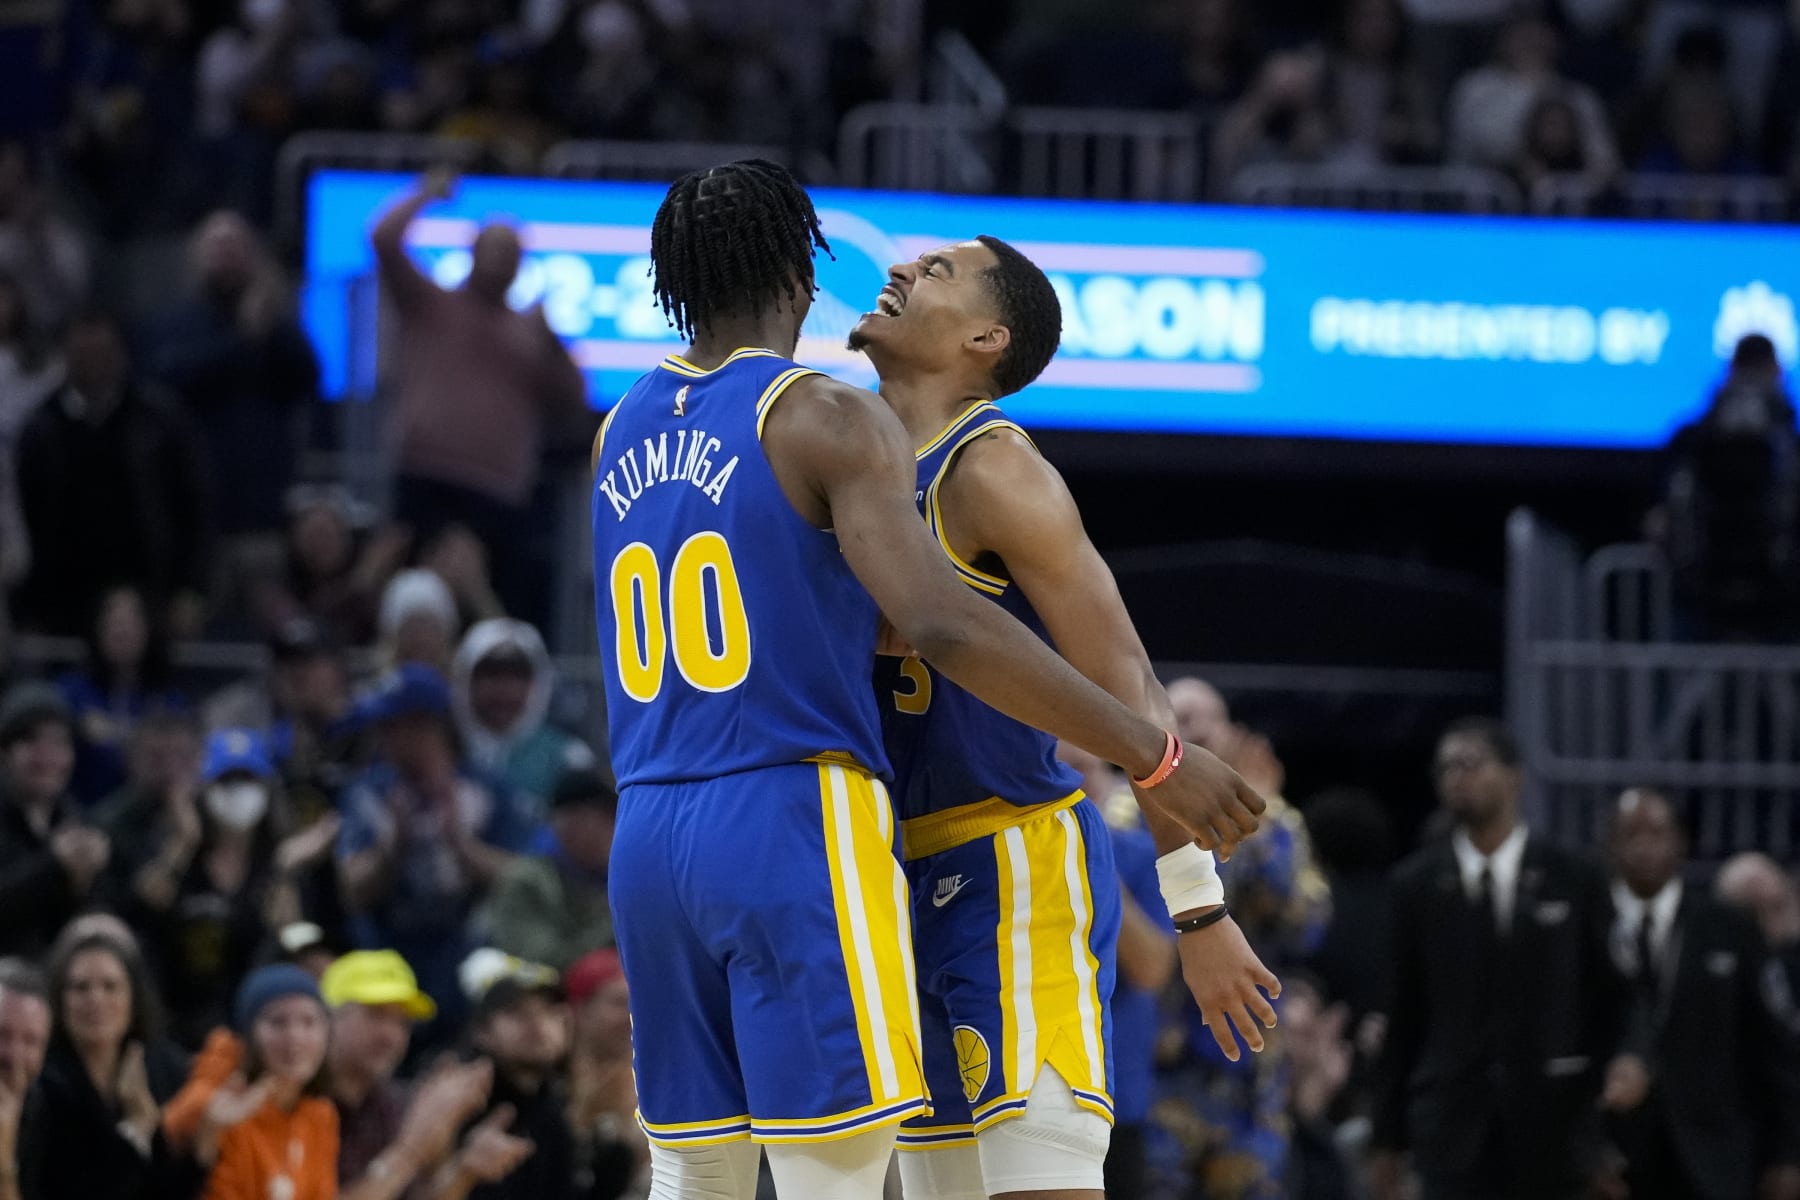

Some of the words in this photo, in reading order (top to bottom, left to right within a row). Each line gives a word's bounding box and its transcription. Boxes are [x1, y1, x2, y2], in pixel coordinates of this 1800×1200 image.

[1048, 274, 1266, 361] ASON
[1309, 297, 1597, 363] PRESENTED
[1599, 307, 1671, 366] BY
[599, 429, 740, 522] KUMINGA
[610, 530, 751, 703] 00
[936, 873, 963, 896] NIKE
